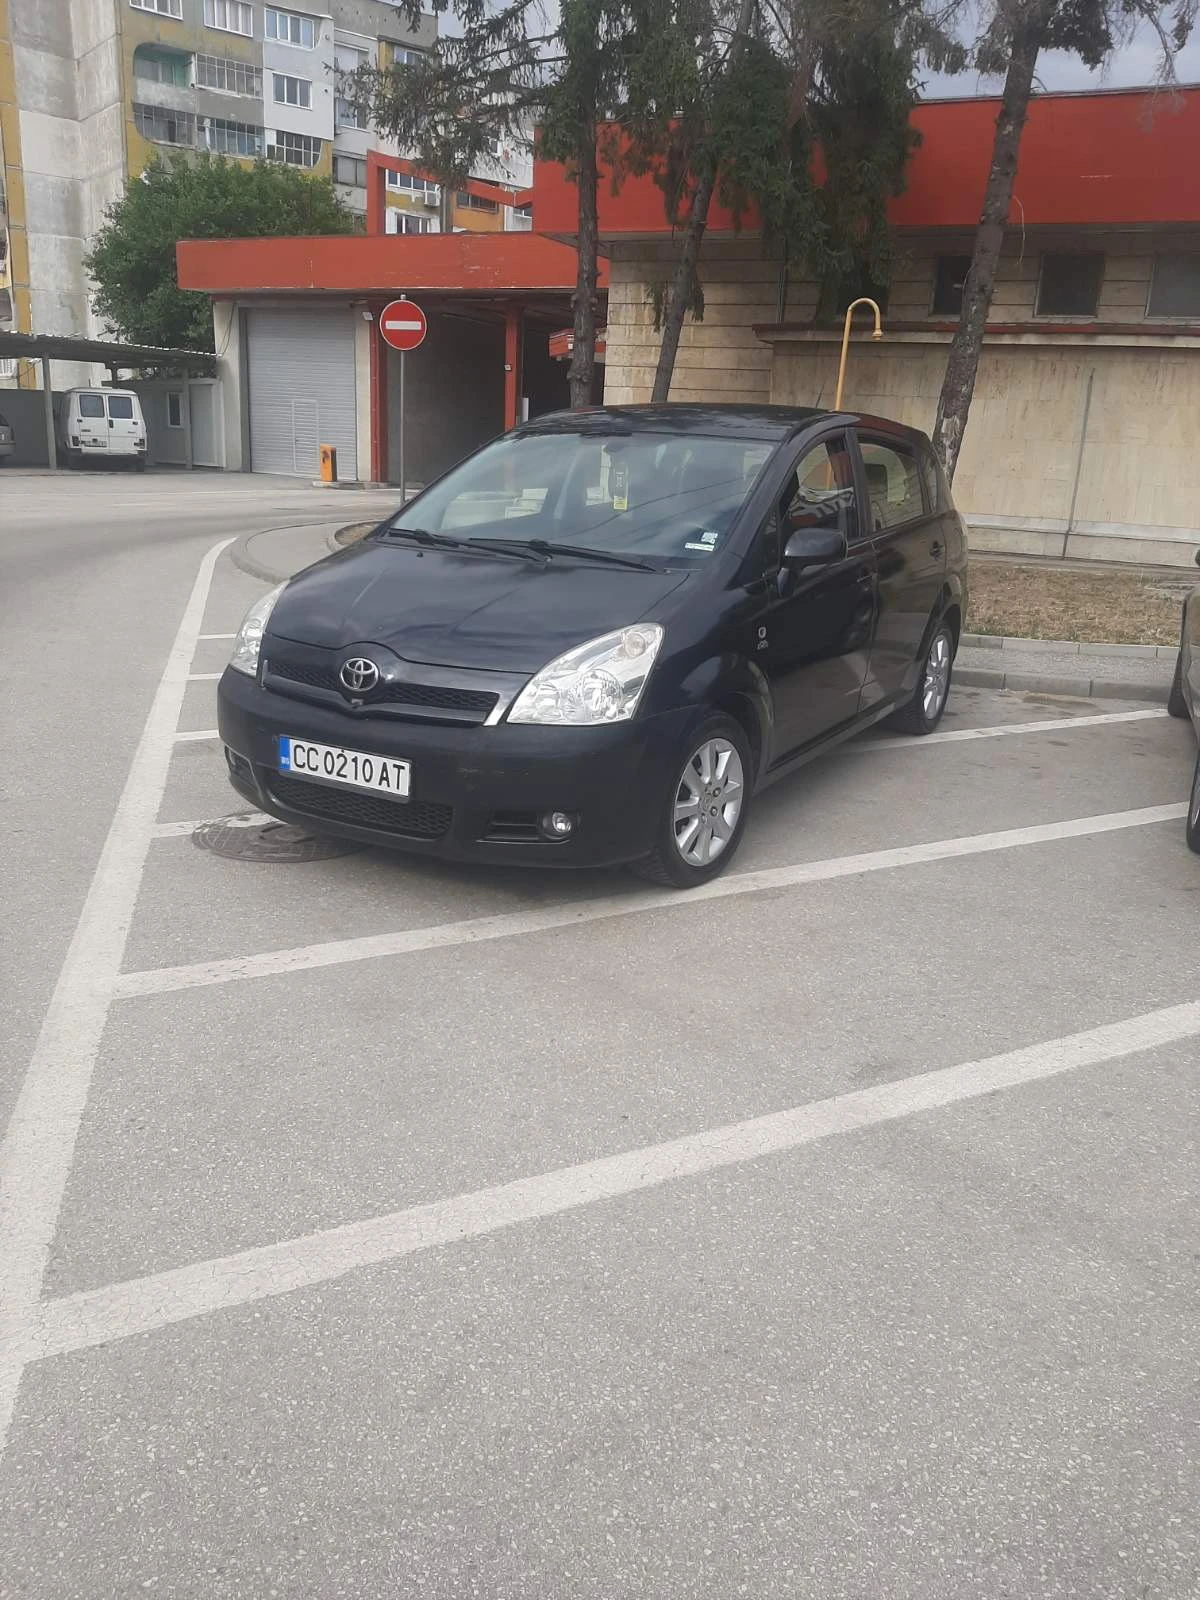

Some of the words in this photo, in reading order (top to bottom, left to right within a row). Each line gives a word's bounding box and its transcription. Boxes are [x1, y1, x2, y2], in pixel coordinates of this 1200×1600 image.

[293, 744, 319, 772] CC
[323, 750, 374, 783] 0210
[378, 761, 405, 790] AT
